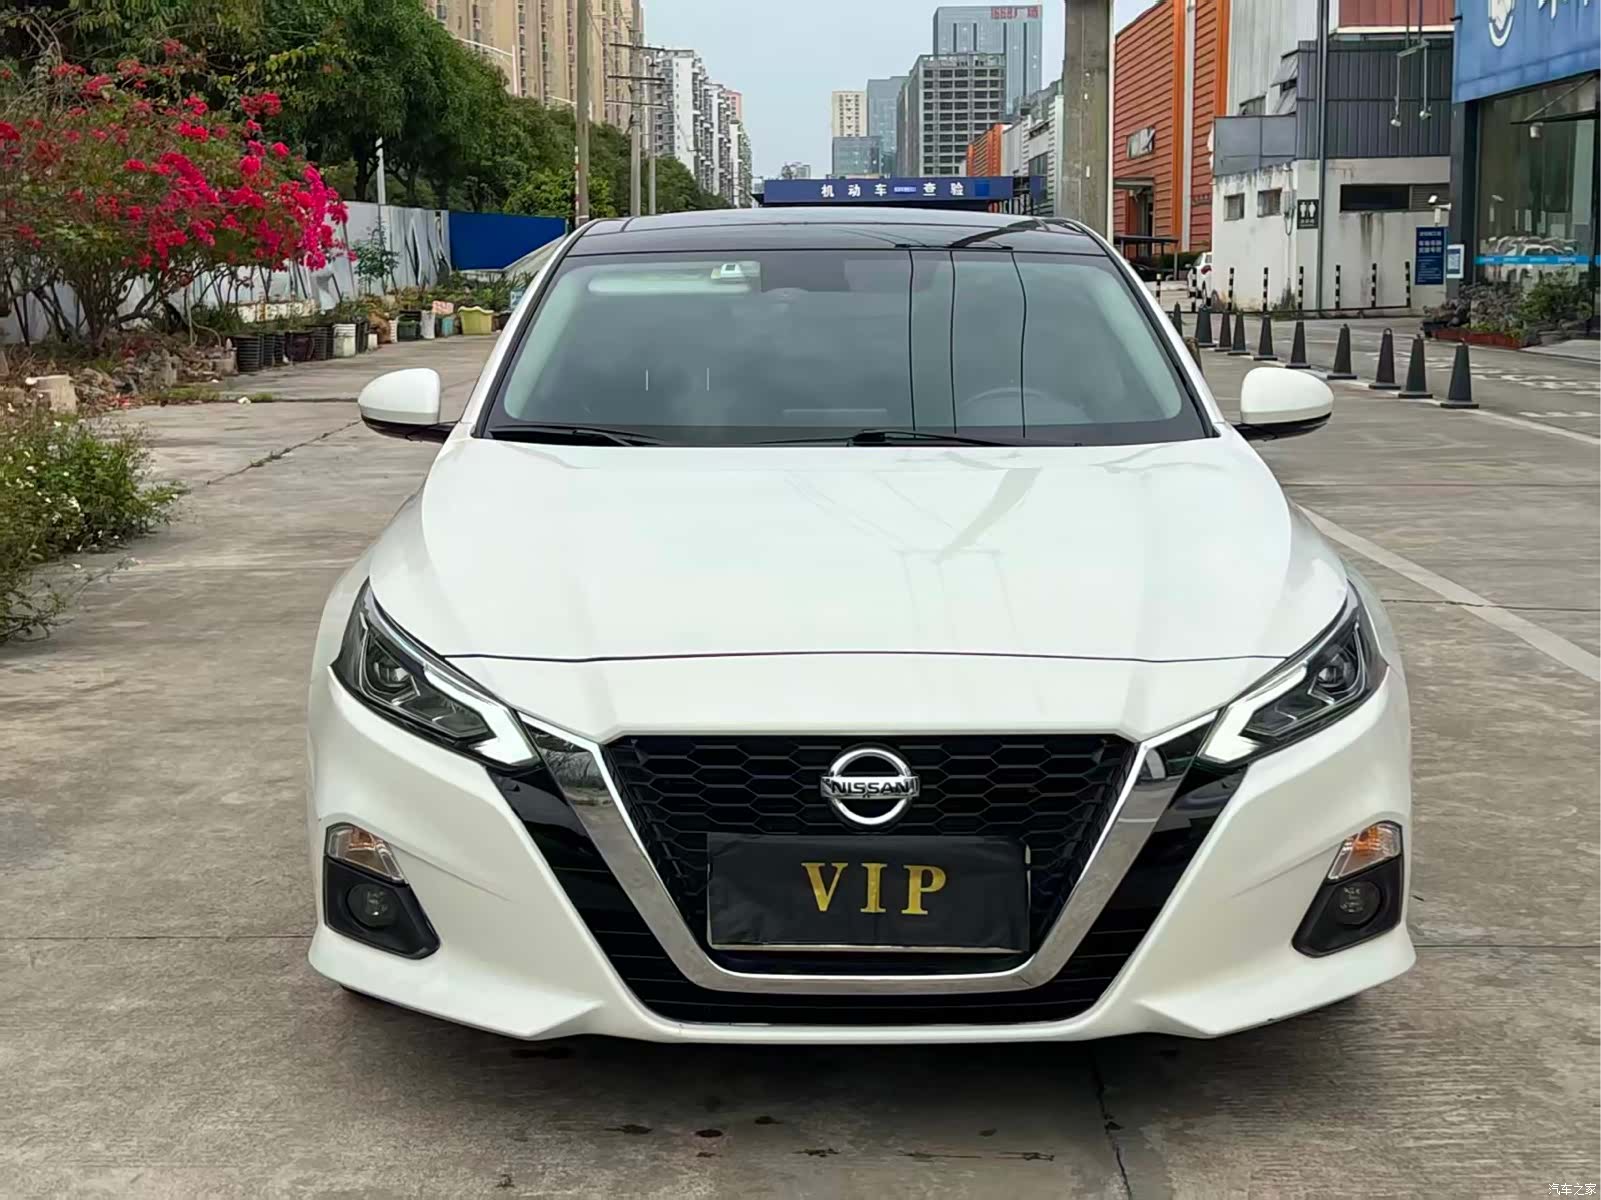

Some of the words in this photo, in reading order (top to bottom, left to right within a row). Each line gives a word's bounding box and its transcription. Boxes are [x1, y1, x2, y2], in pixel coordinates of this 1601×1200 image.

[821, 182, 887, 197] 机动车
[923, 182, 964, 197] 查验
[831, 781, 911, 795] NISSAN
[800, 862, 947, 915] VIP
